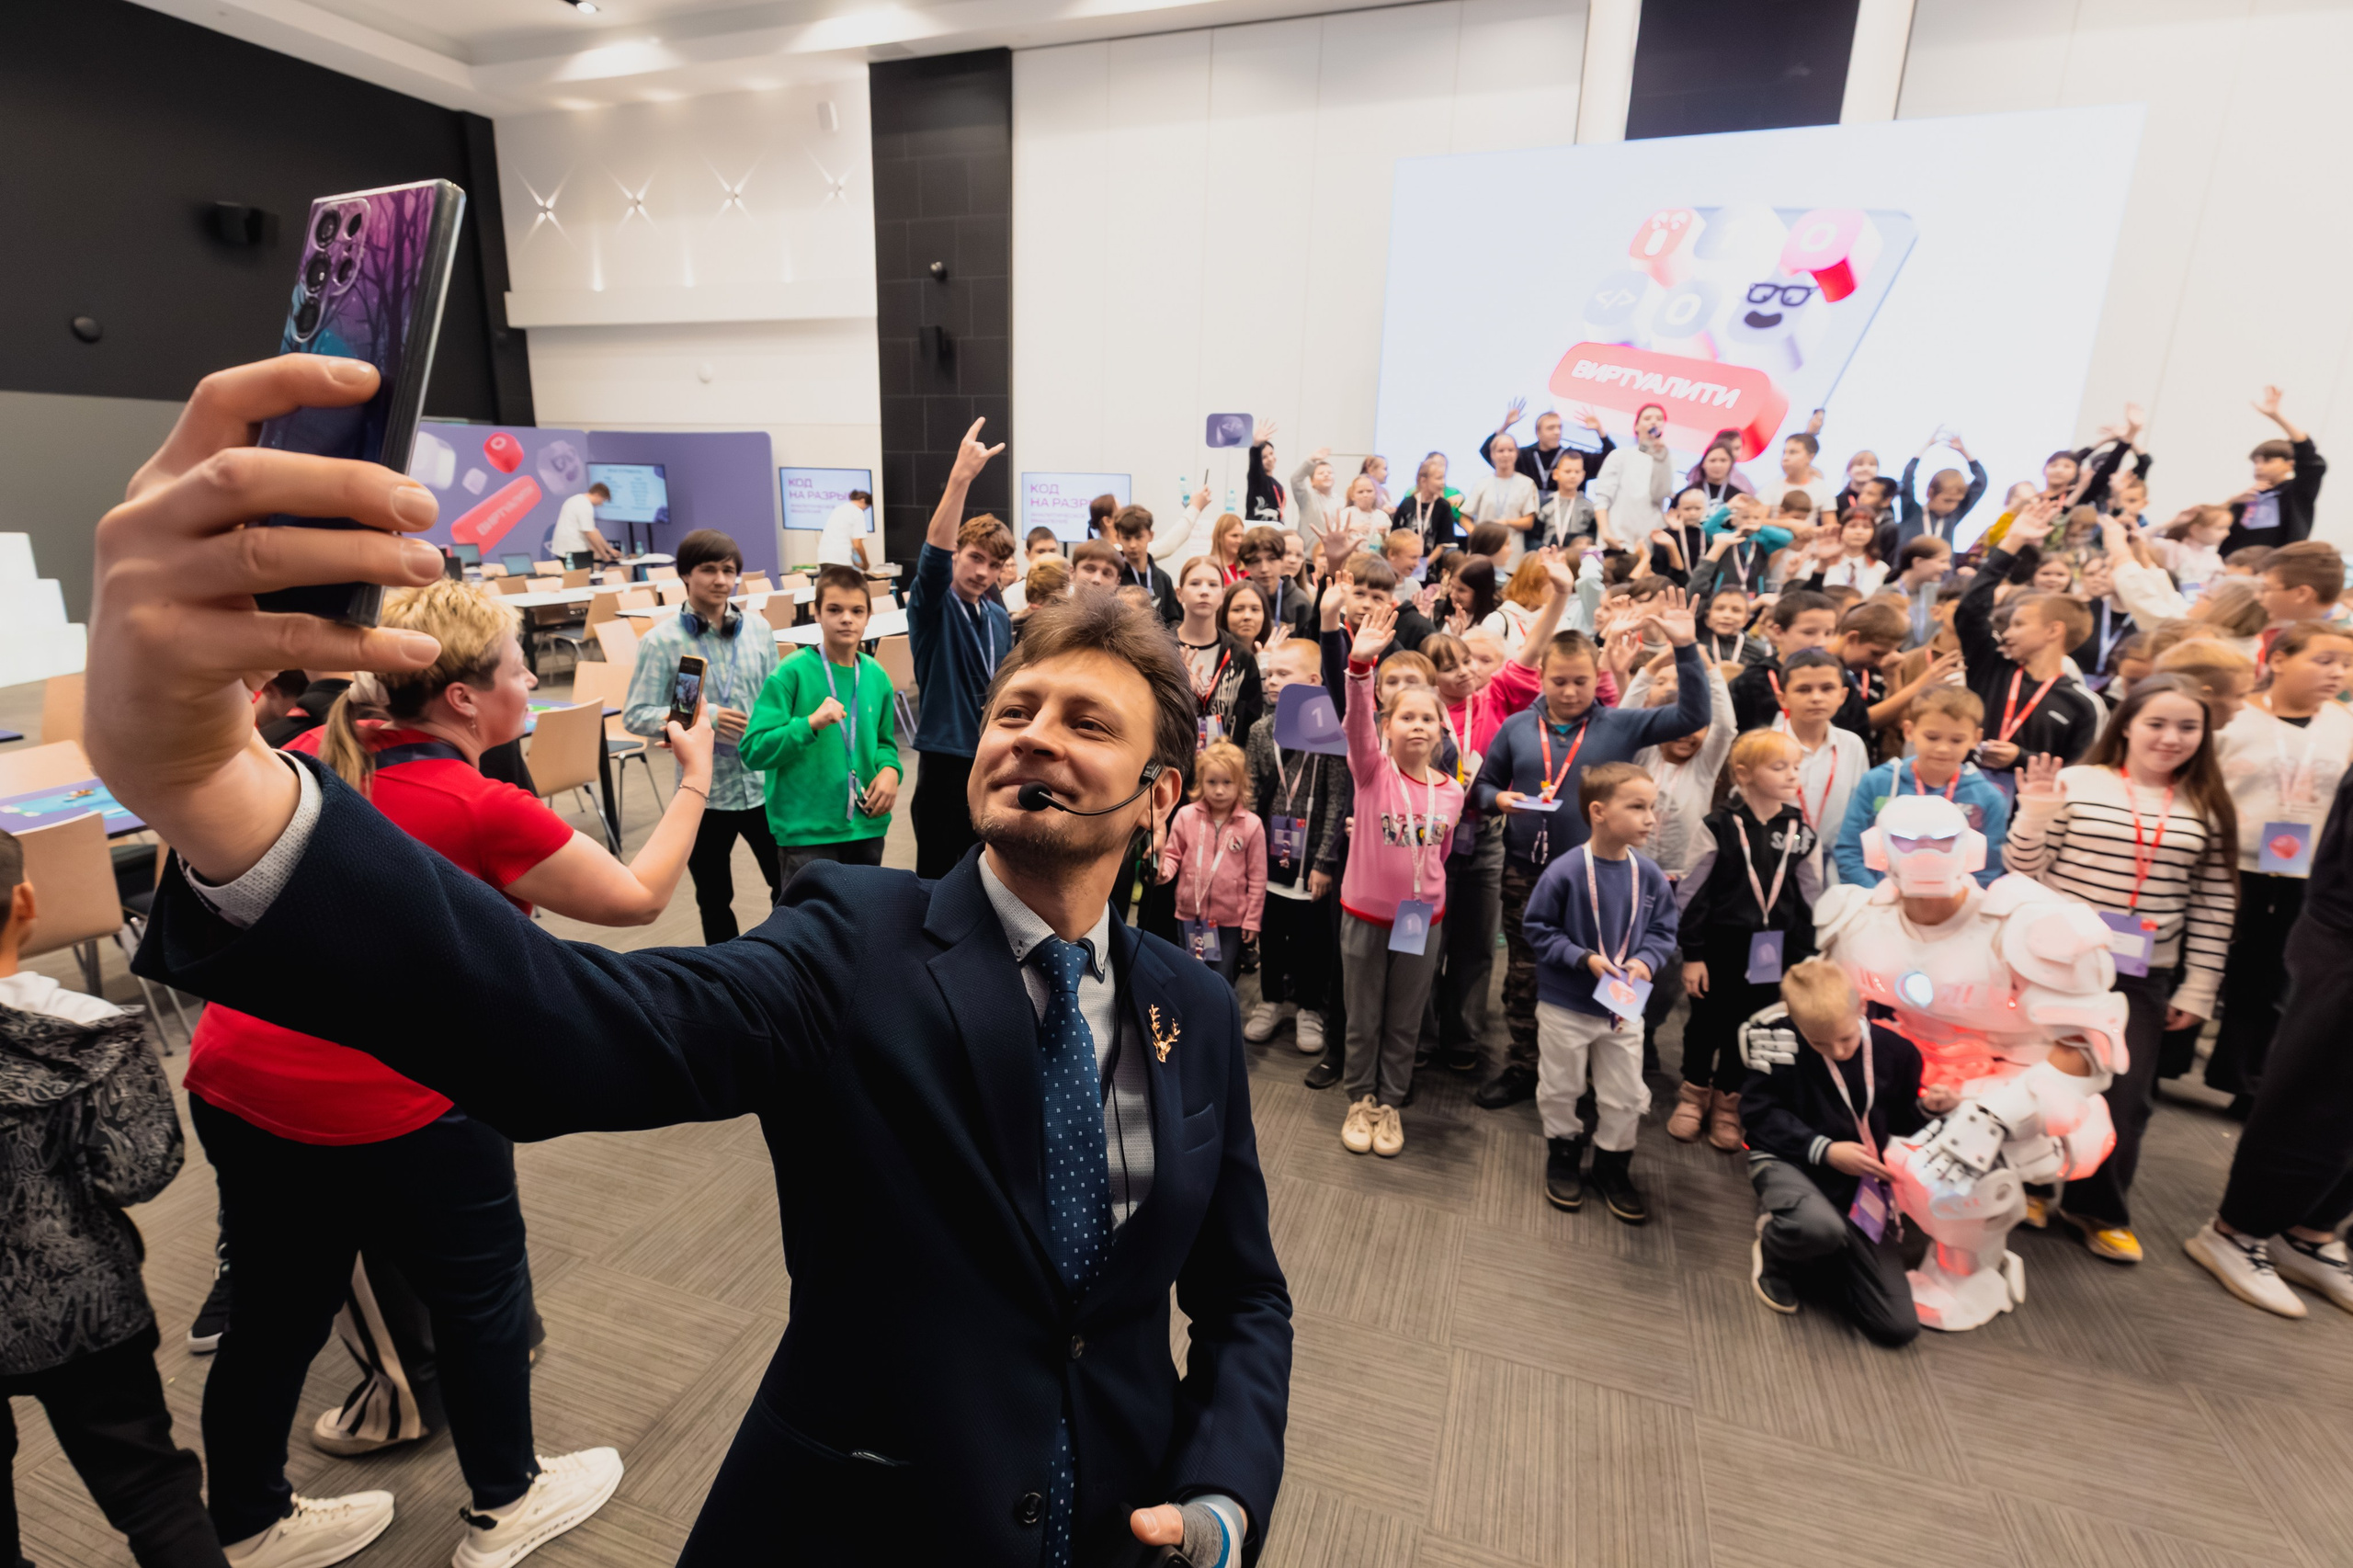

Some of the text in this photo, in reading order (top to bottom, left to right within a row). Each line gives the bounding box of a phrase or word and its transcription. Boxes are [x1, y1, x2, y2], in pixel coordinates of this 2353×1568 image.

[1571, 359, 1742, 409] ВИРТУАЛИТИ
[788, 478, 813, 488] КОД
[1029, 483, 1060, 494] КОД
[789, 490, 851, 501] НА РАЗРЫ
[1029, 498, 1091, 508] НА РАЗР
[1312, 707, 1324, 728] 1
